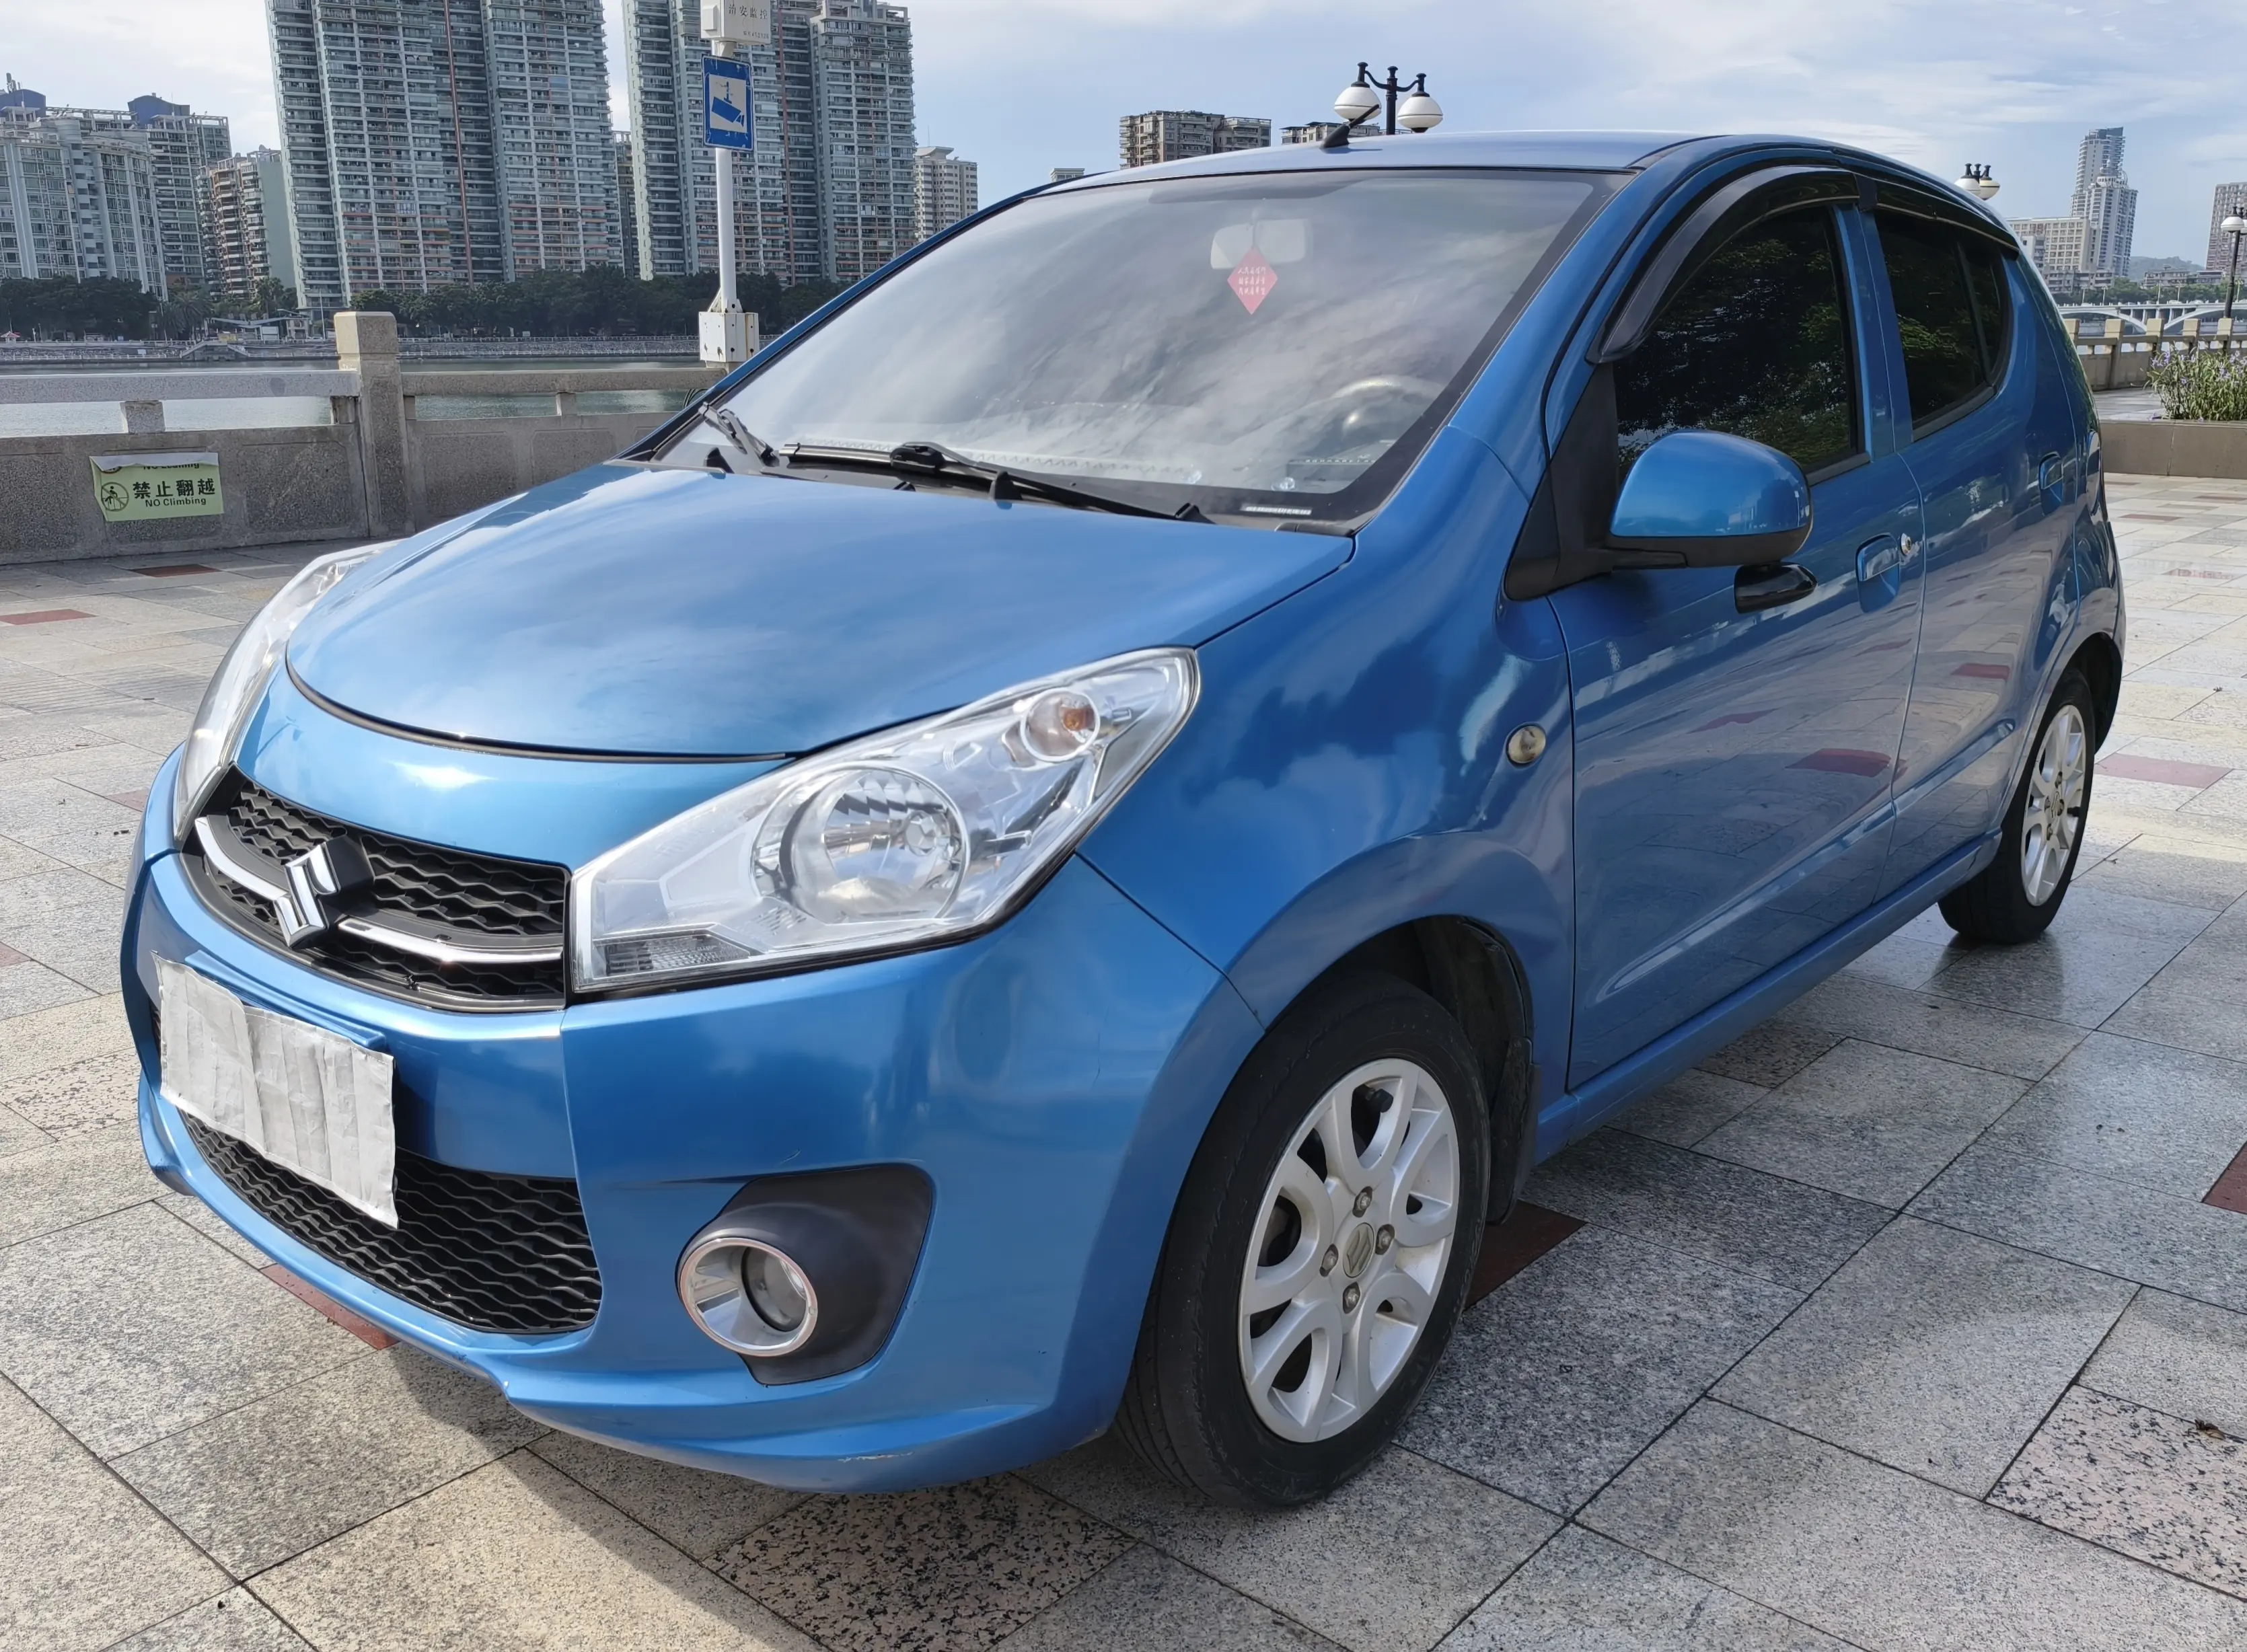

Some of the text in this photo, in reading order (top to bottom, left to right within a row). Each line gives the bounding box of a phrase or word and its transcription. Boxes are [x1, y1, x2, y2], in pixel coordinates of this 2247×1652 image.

[729, 4, 768, 20] 治安监控
[133, 478, 215, 498] 禁止翻越
[145, 497, 206, 507] NO Climbing
